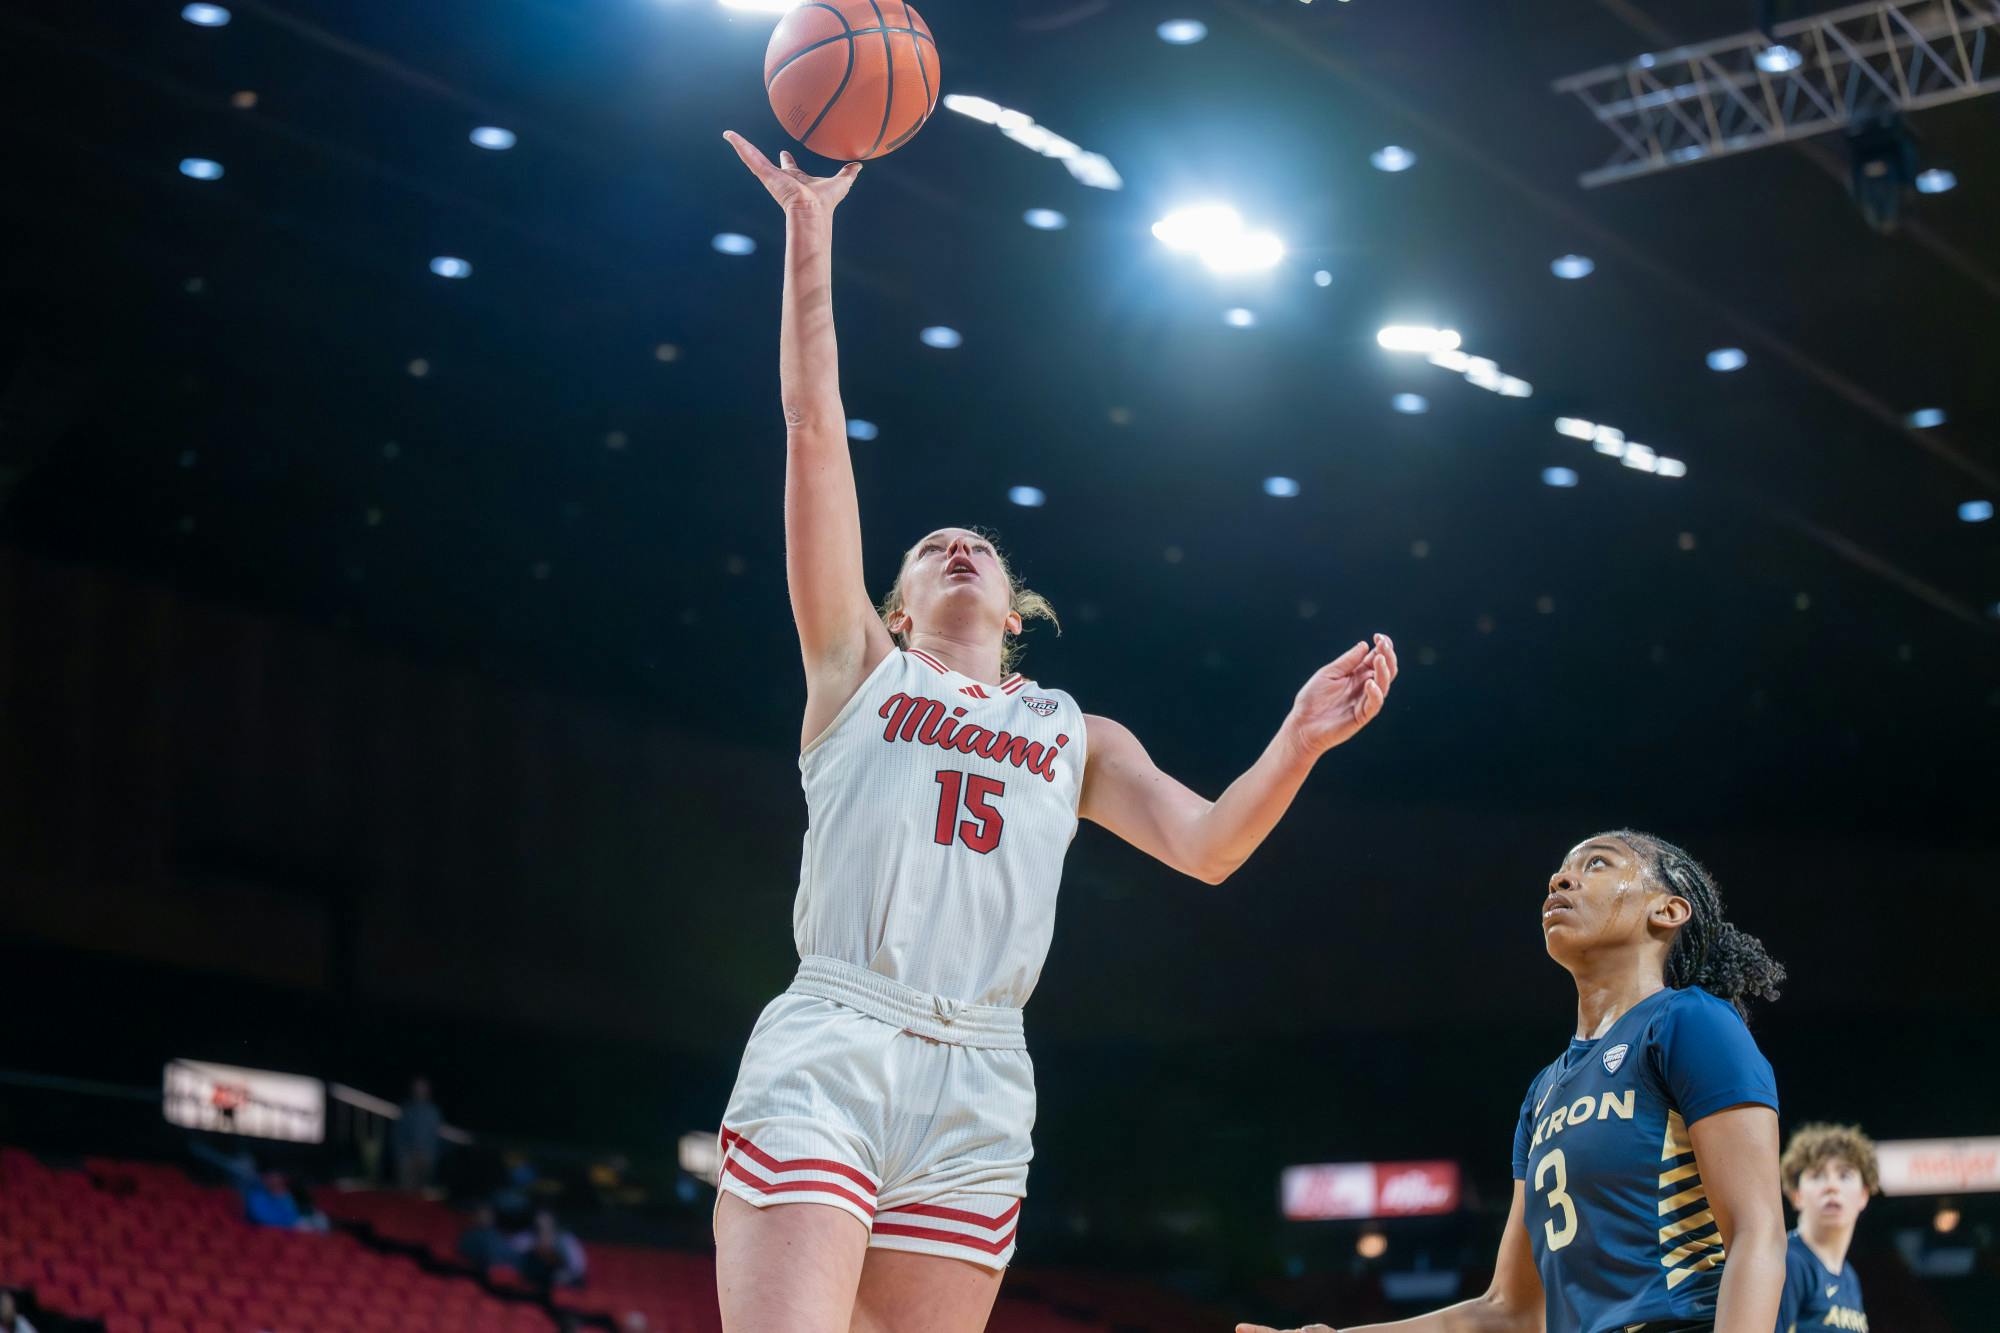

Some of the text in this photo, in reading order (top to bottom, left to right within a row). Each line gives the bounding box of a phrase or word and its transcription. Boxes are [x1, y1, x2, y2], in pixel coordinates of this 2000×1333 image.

[878, 692, 1070, 783] Miami
[934, 769, 1006, 855] 15
[1527, 1089, 1636, 1160] KRON
[1534, 1148, 1578, 1252] 3
